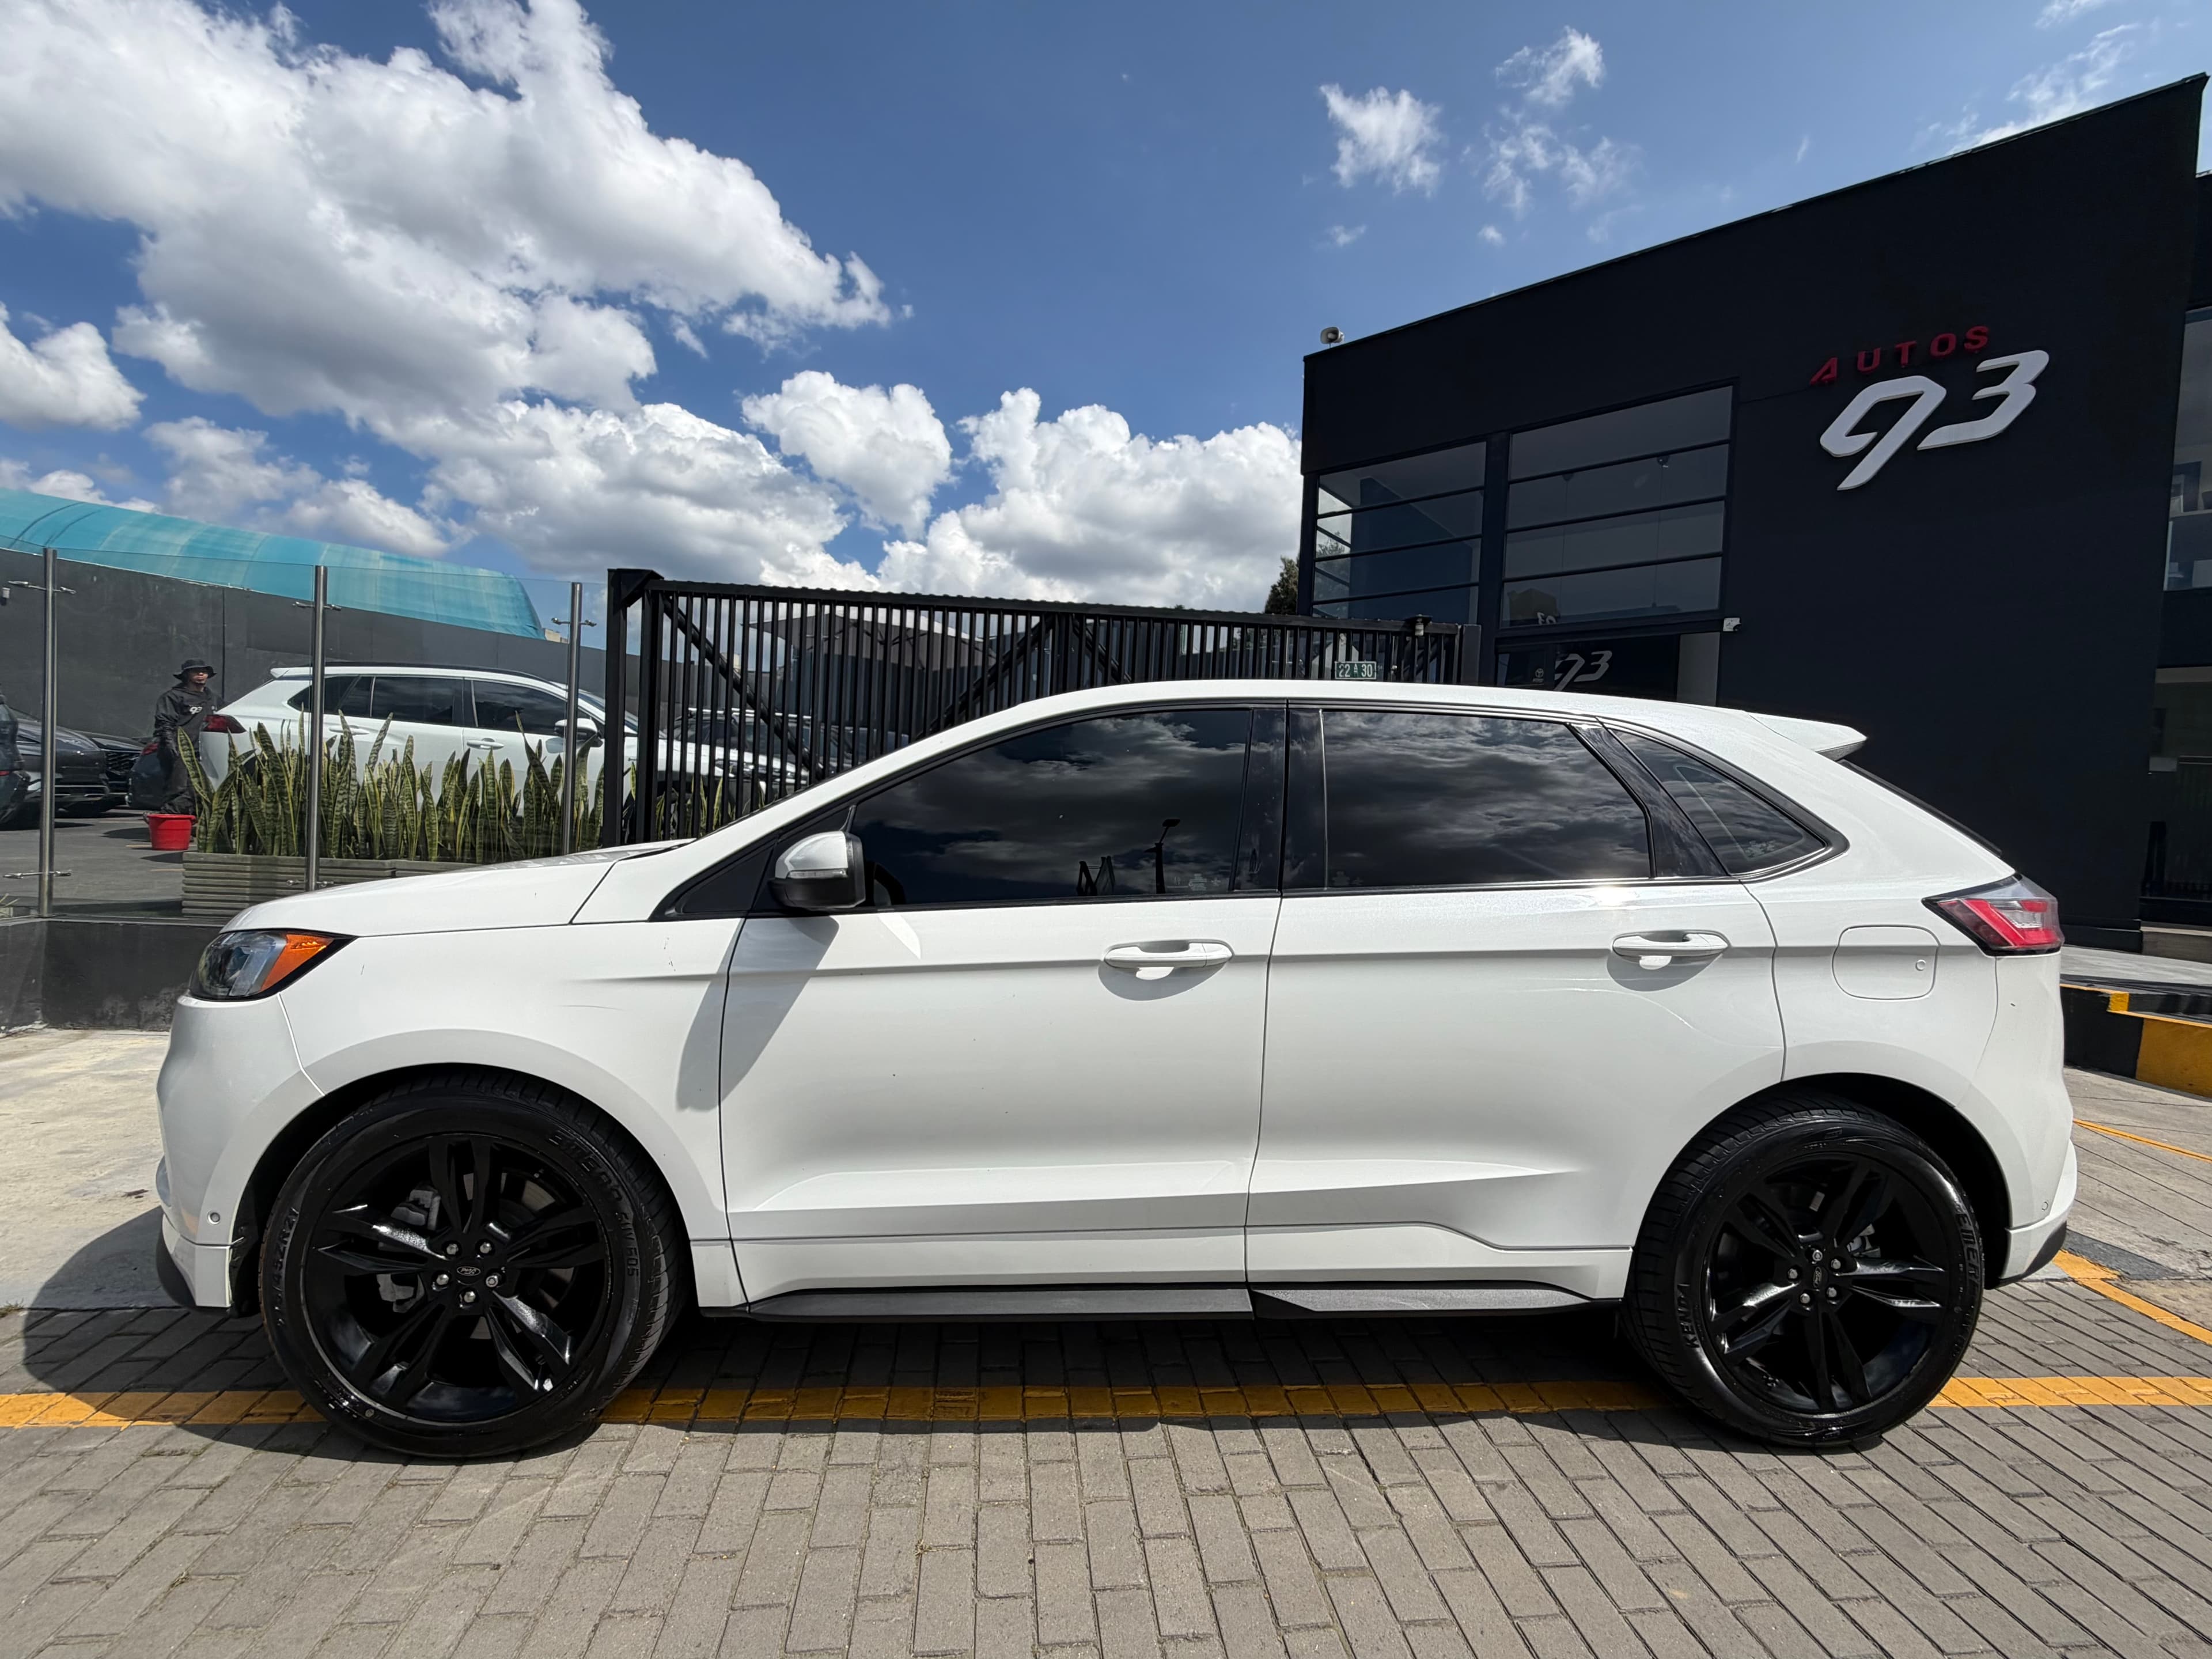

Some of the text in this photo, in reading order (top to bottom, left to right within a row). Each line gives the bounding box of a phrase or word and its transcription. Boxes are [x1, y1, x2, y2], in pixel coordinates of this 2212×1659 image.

[1810, 325, 1990, 385] AUTOS
[1820, 350, 2050, 490] 93
[1339, 664, 1350, 677] 22
[1361, 664, 1373, 677] 30
[1554, 650, 1612, 691] 93
[190, 706, 203, 714] 93
[1677, 1283, 1700, 1348] KENDA
